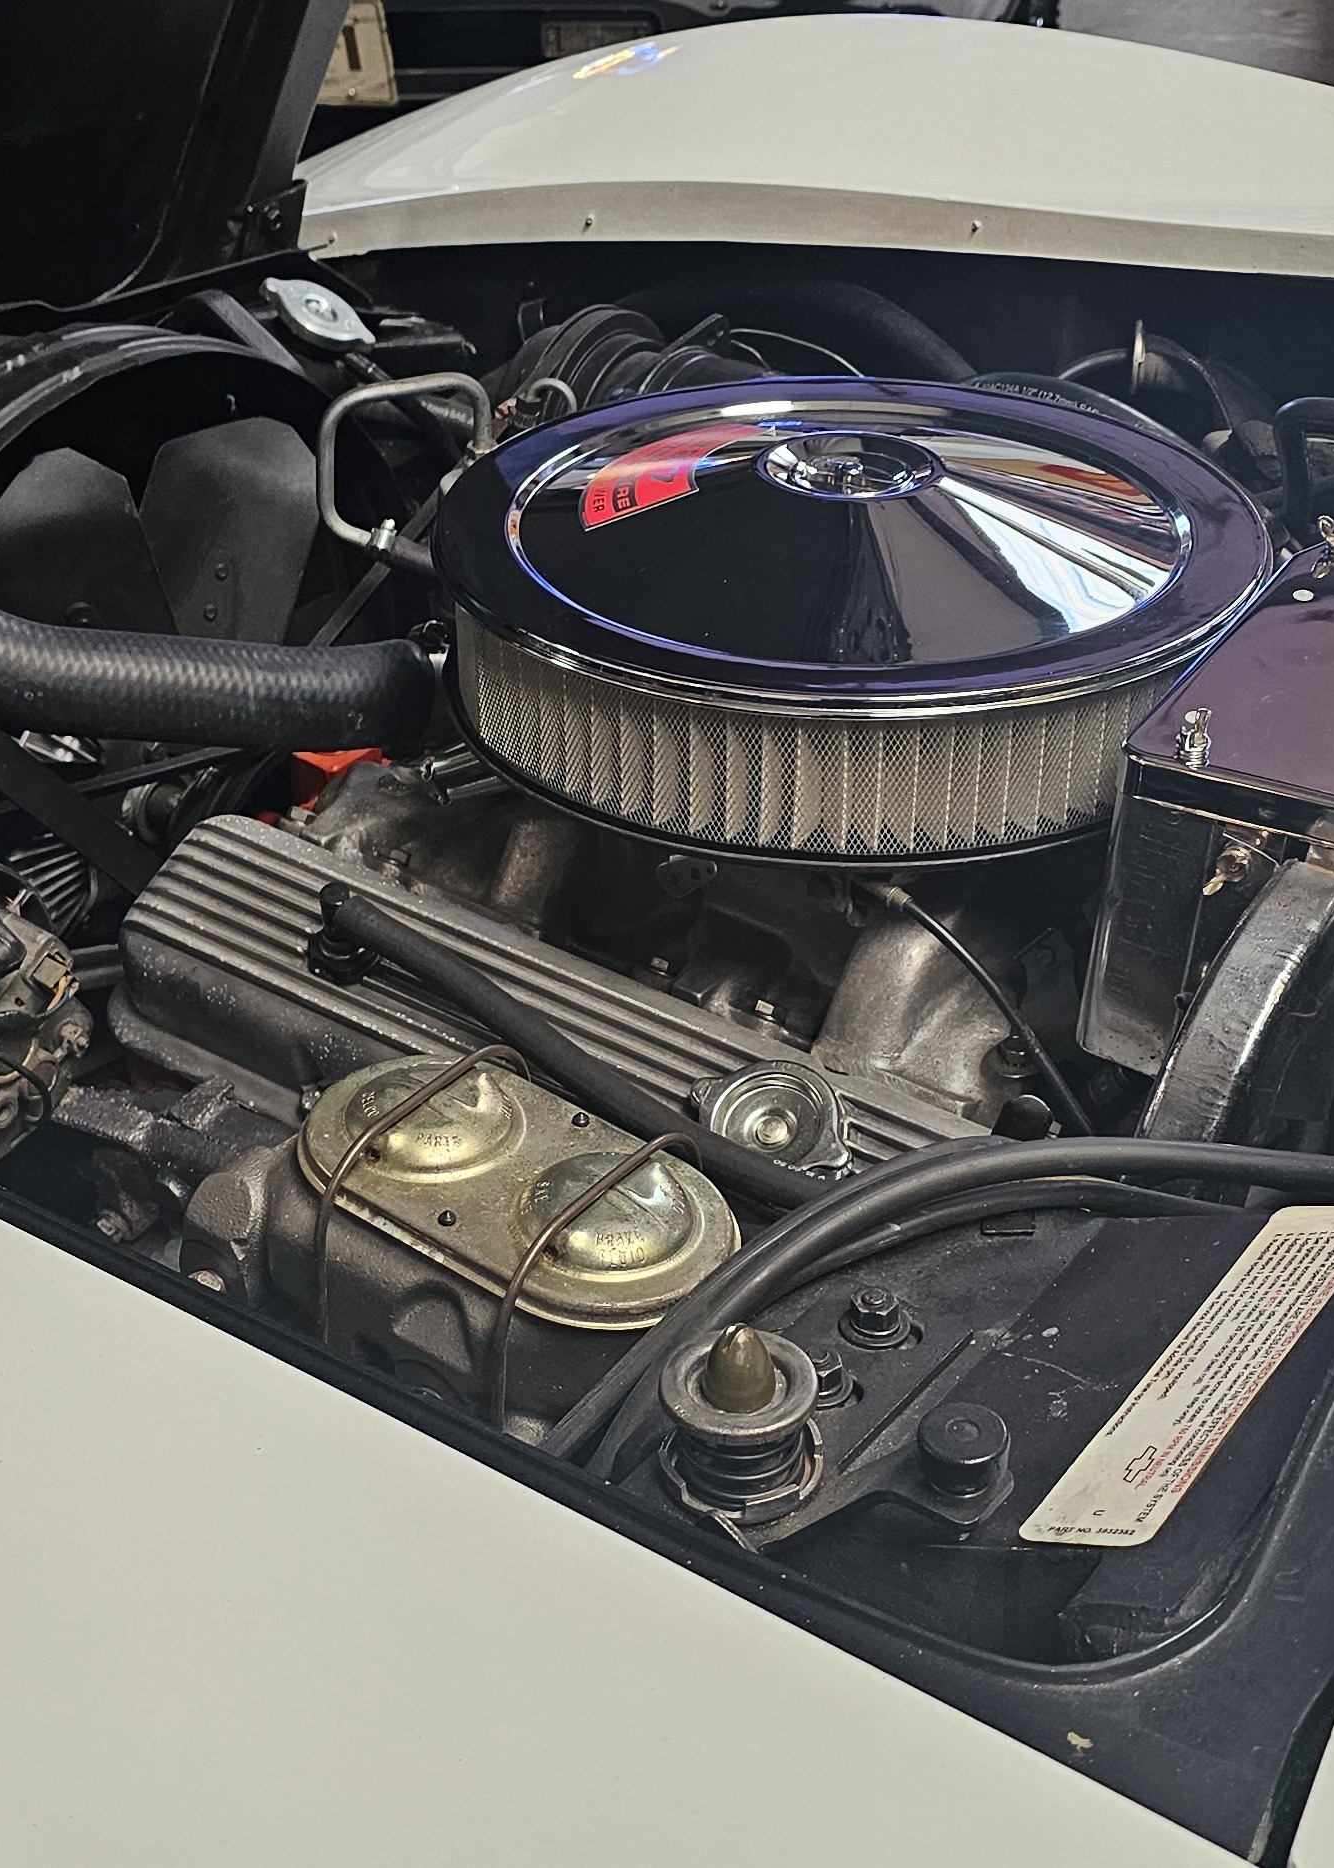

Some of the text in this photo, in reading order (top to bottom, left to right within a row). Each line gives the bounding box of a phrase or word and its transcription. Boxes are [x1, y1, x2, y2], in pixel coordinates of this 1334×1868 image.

[1280, 1307, 1317, 1346] EQUIPPED
[1288, 1306, 1305, 1319] ARE
[1258, 1321, 1294, 1358] NECESSARY
[1226, 1370, 1257, 1400] MAINTAIN
[1244, 1361, 1277, 1394] REDUCE
[1213, 1396, 1250, 1435] EXHAUST
[1215, 1402, 1233, 1415] THE
[1157, 1476, 1176, 1492] THE
[1134, 1493, 1163, 1522] SYSTEM
[1047, 1525, 1075, 1533] PART
